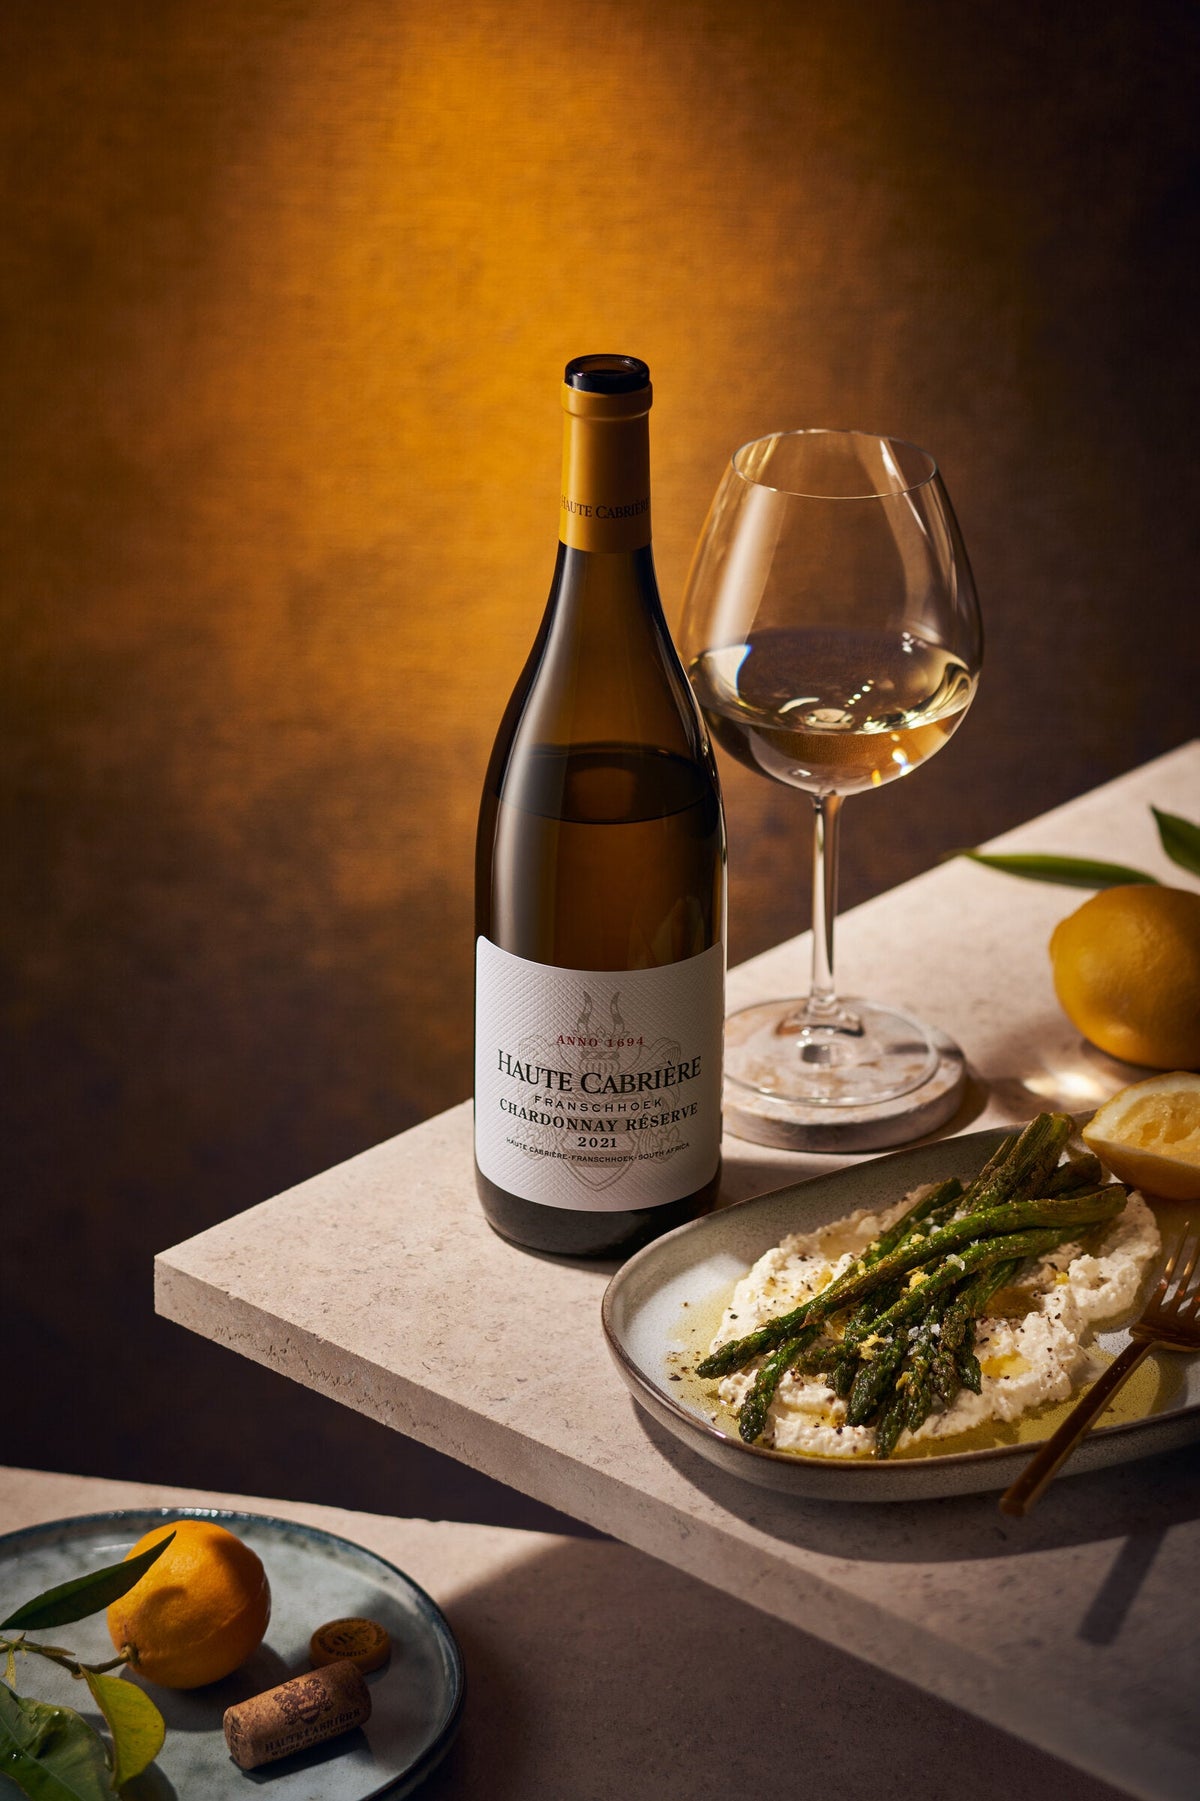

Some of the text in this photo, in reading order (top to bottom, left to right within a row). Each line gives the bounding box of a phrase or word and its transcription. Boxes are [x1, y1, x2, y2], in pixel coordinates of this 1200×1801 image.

[560, 495, 593, 518] HAUTE
[556, 1035, 645, 1048] ANNO 1694
[497, 1048, 702, 1095] HAUTE CABRIÈRE
[533, 1095, 662, 1113] FRANSCHHOEK
[499, 1097, 698, 1132] CHARDONNAY RÉSERVE
[506, 1136, 528, 1151] HAUTE
[665, 1142, 690, 1156] AFRICA
[577, 1136, 618, 1148] 2021
